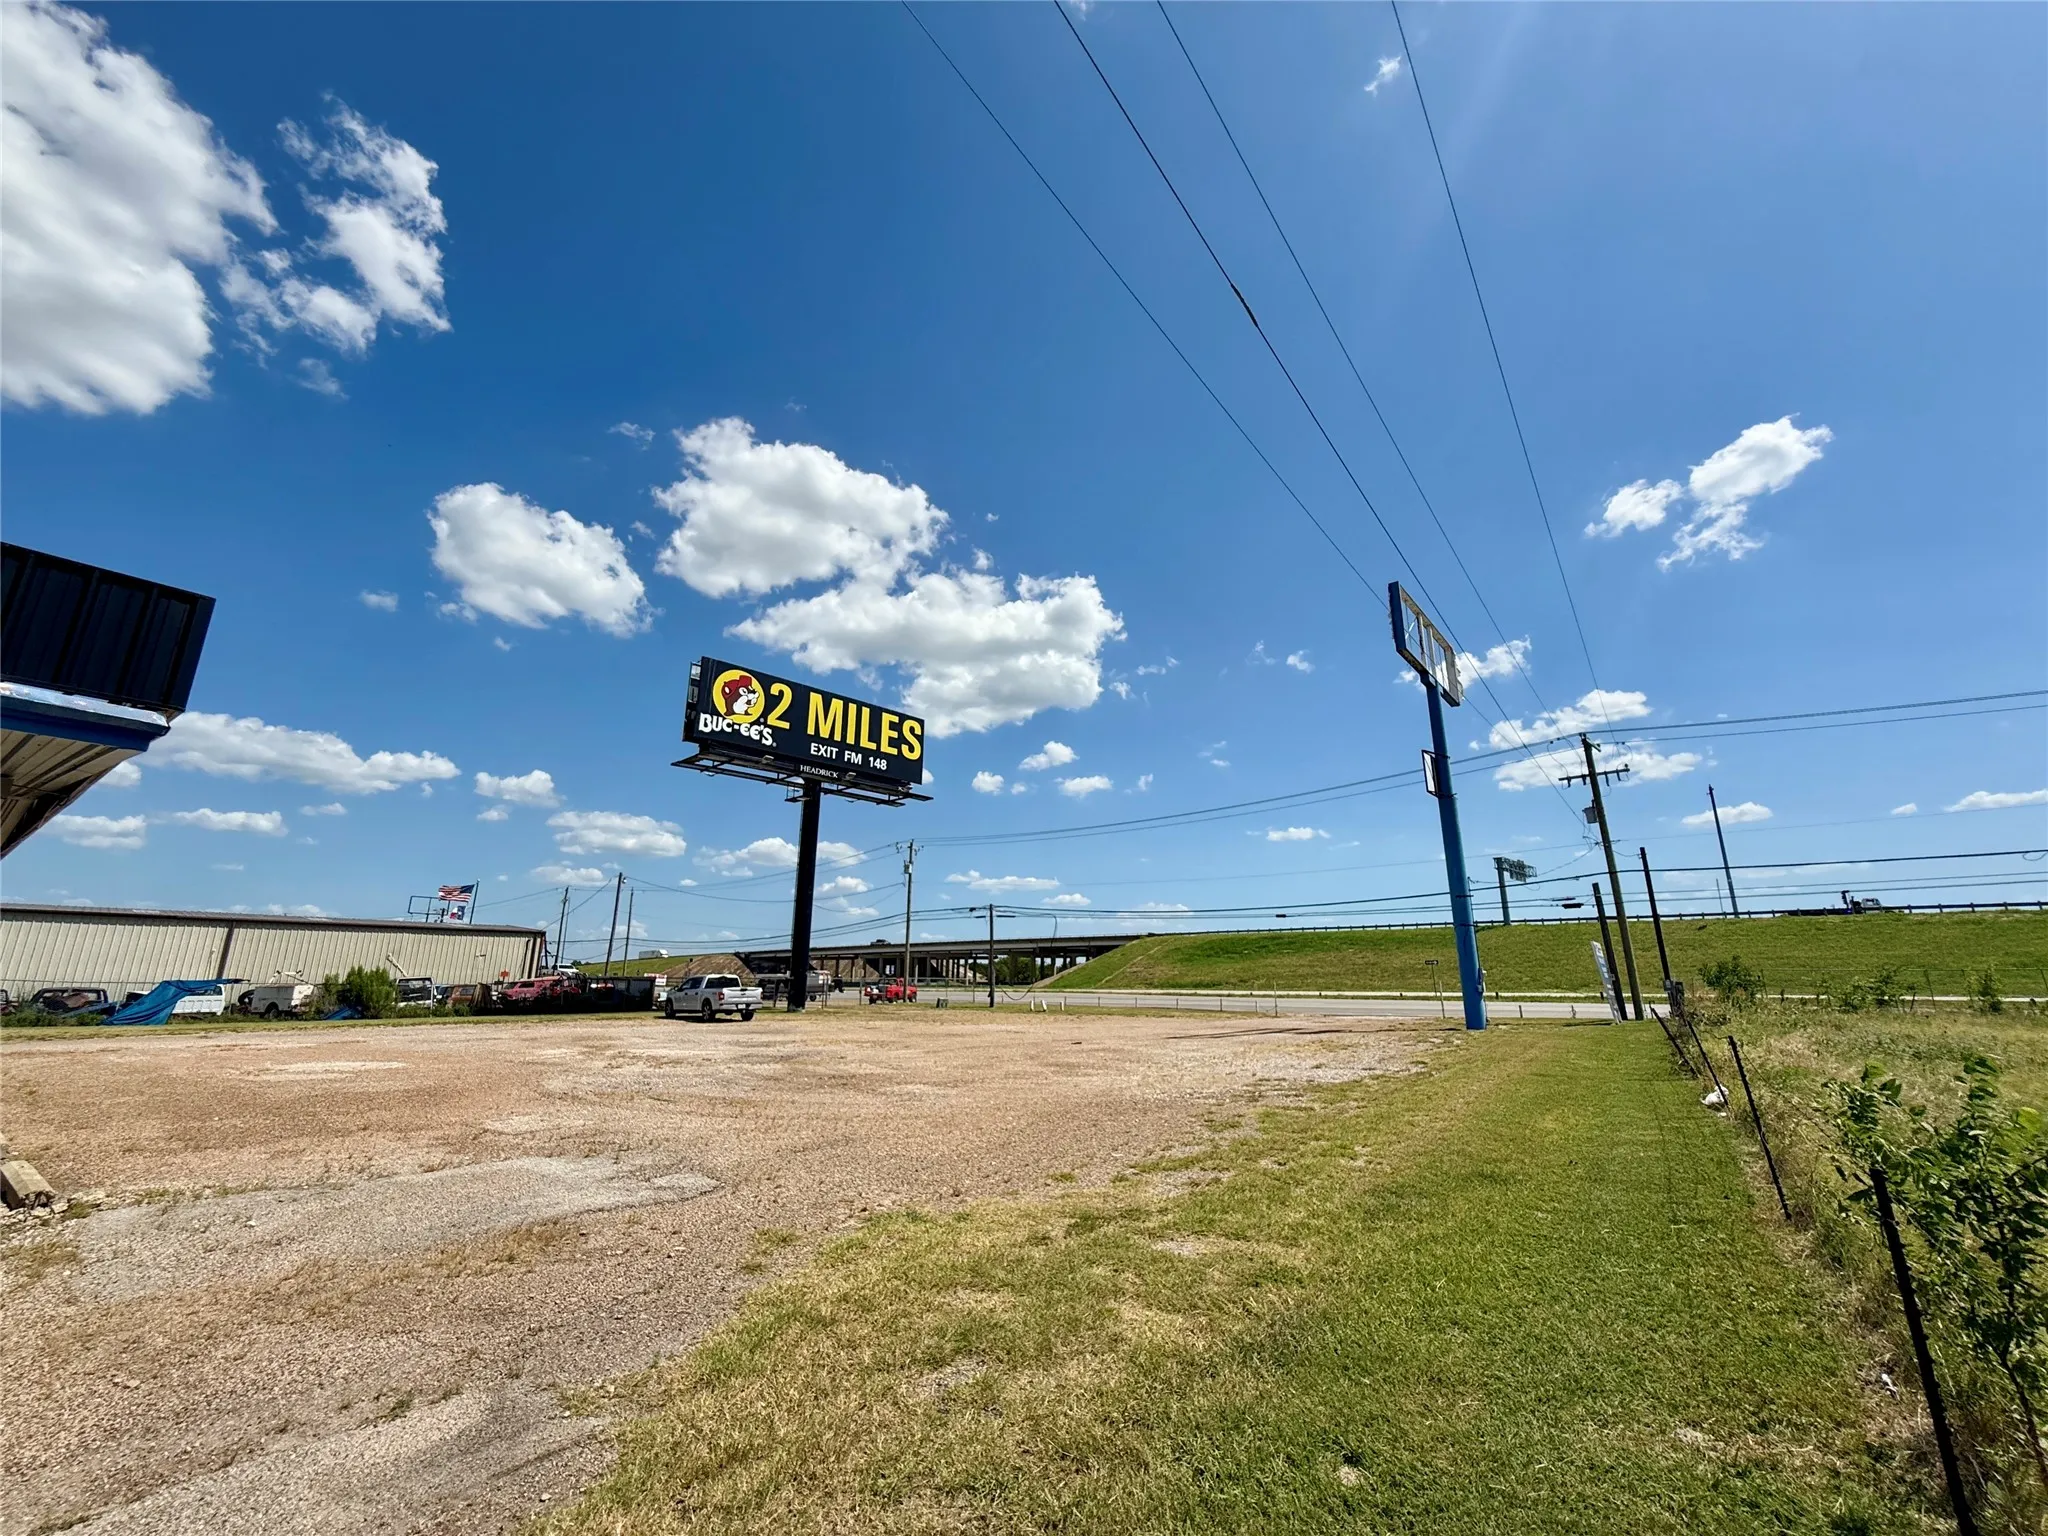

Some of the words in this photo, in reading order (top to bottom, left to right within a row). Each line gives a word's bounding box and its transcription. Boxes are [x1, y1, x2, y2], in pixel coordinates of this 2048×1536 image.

[767, 682, 793, 730] 2
[807, 691, 922, 760] MILES
[810, 742, 839, 759] EXIT
[844, 750, 862, 765] FM
[868, 756, 887, 771] 148
[800, 764, 839, 779] HEADRICK
